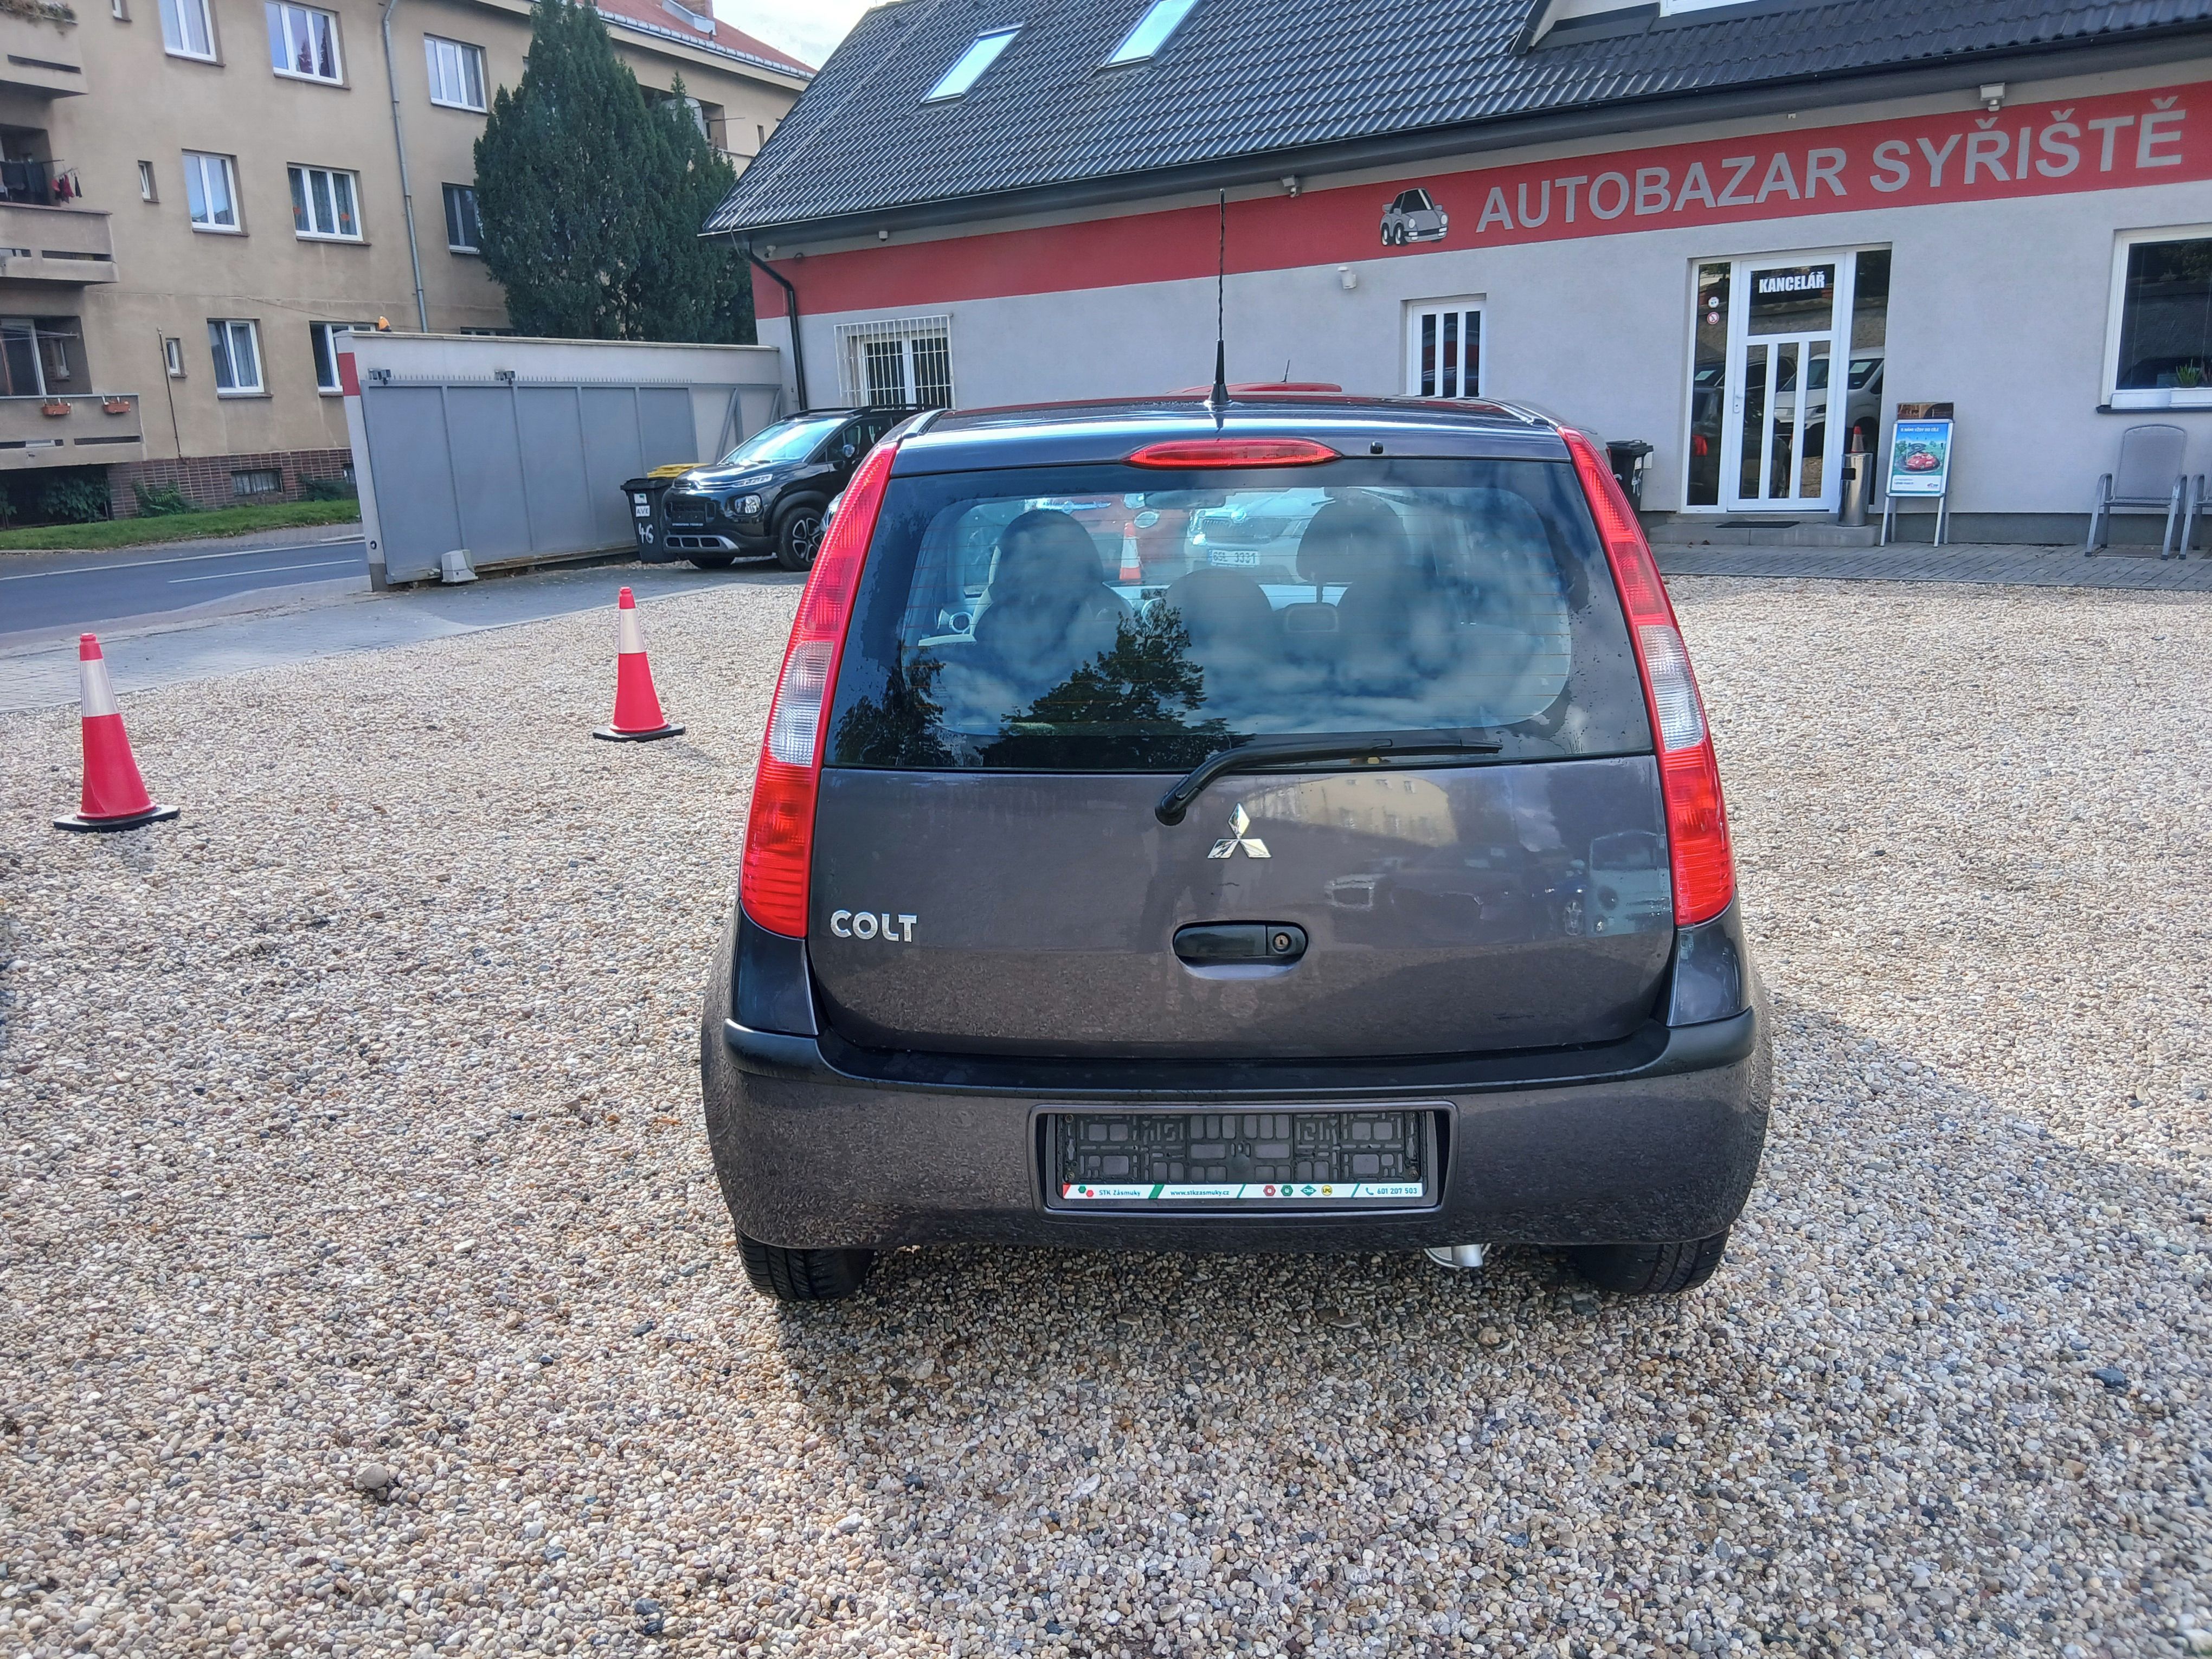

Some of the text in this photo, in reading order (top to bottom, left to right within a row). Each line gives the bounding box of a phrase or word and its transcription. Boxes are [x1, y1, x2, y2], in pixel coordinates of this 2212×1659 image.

[1475, 96, 2186, 233] AUTOBAZAR SYŘIŠTĚ
[1759, 271, 1825, 293] KANCELÁŘ
[636, 506, 649, 515] AVE
[639, 523, 654, 544] 46
[831, 910, 917, 942] COLT
